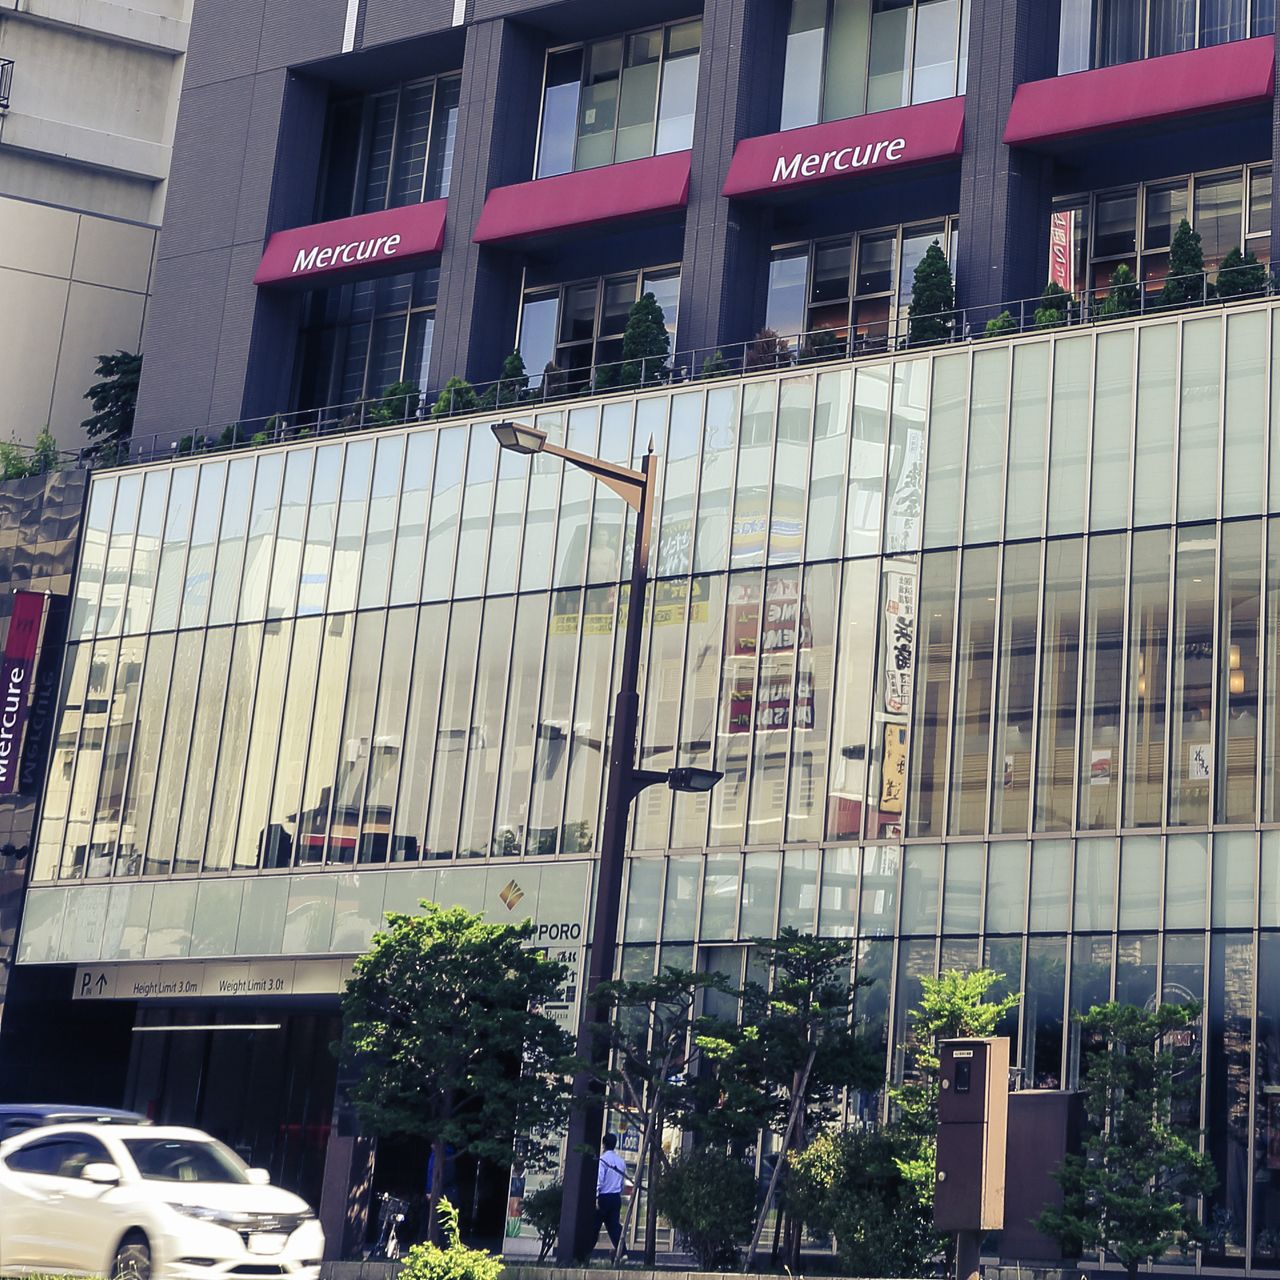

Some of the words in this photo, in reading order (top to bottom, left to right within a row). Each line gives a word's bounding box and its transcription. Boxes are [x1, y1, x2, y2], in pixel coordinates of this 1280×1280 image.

[772, 136, 906, 184] Mercure
[292, 231, 401, 274] Mercure
[81, 972, 92, 996] P
[133, 981, 158, 997] Height
[158, 981, 177, 994] Limit
[178, 980, 198, 993] 3.0m
[219, 978, 247, 995] Weight
[247, 979, 267, 992] Limit
[269, 978, 284, 991] 3.0t
